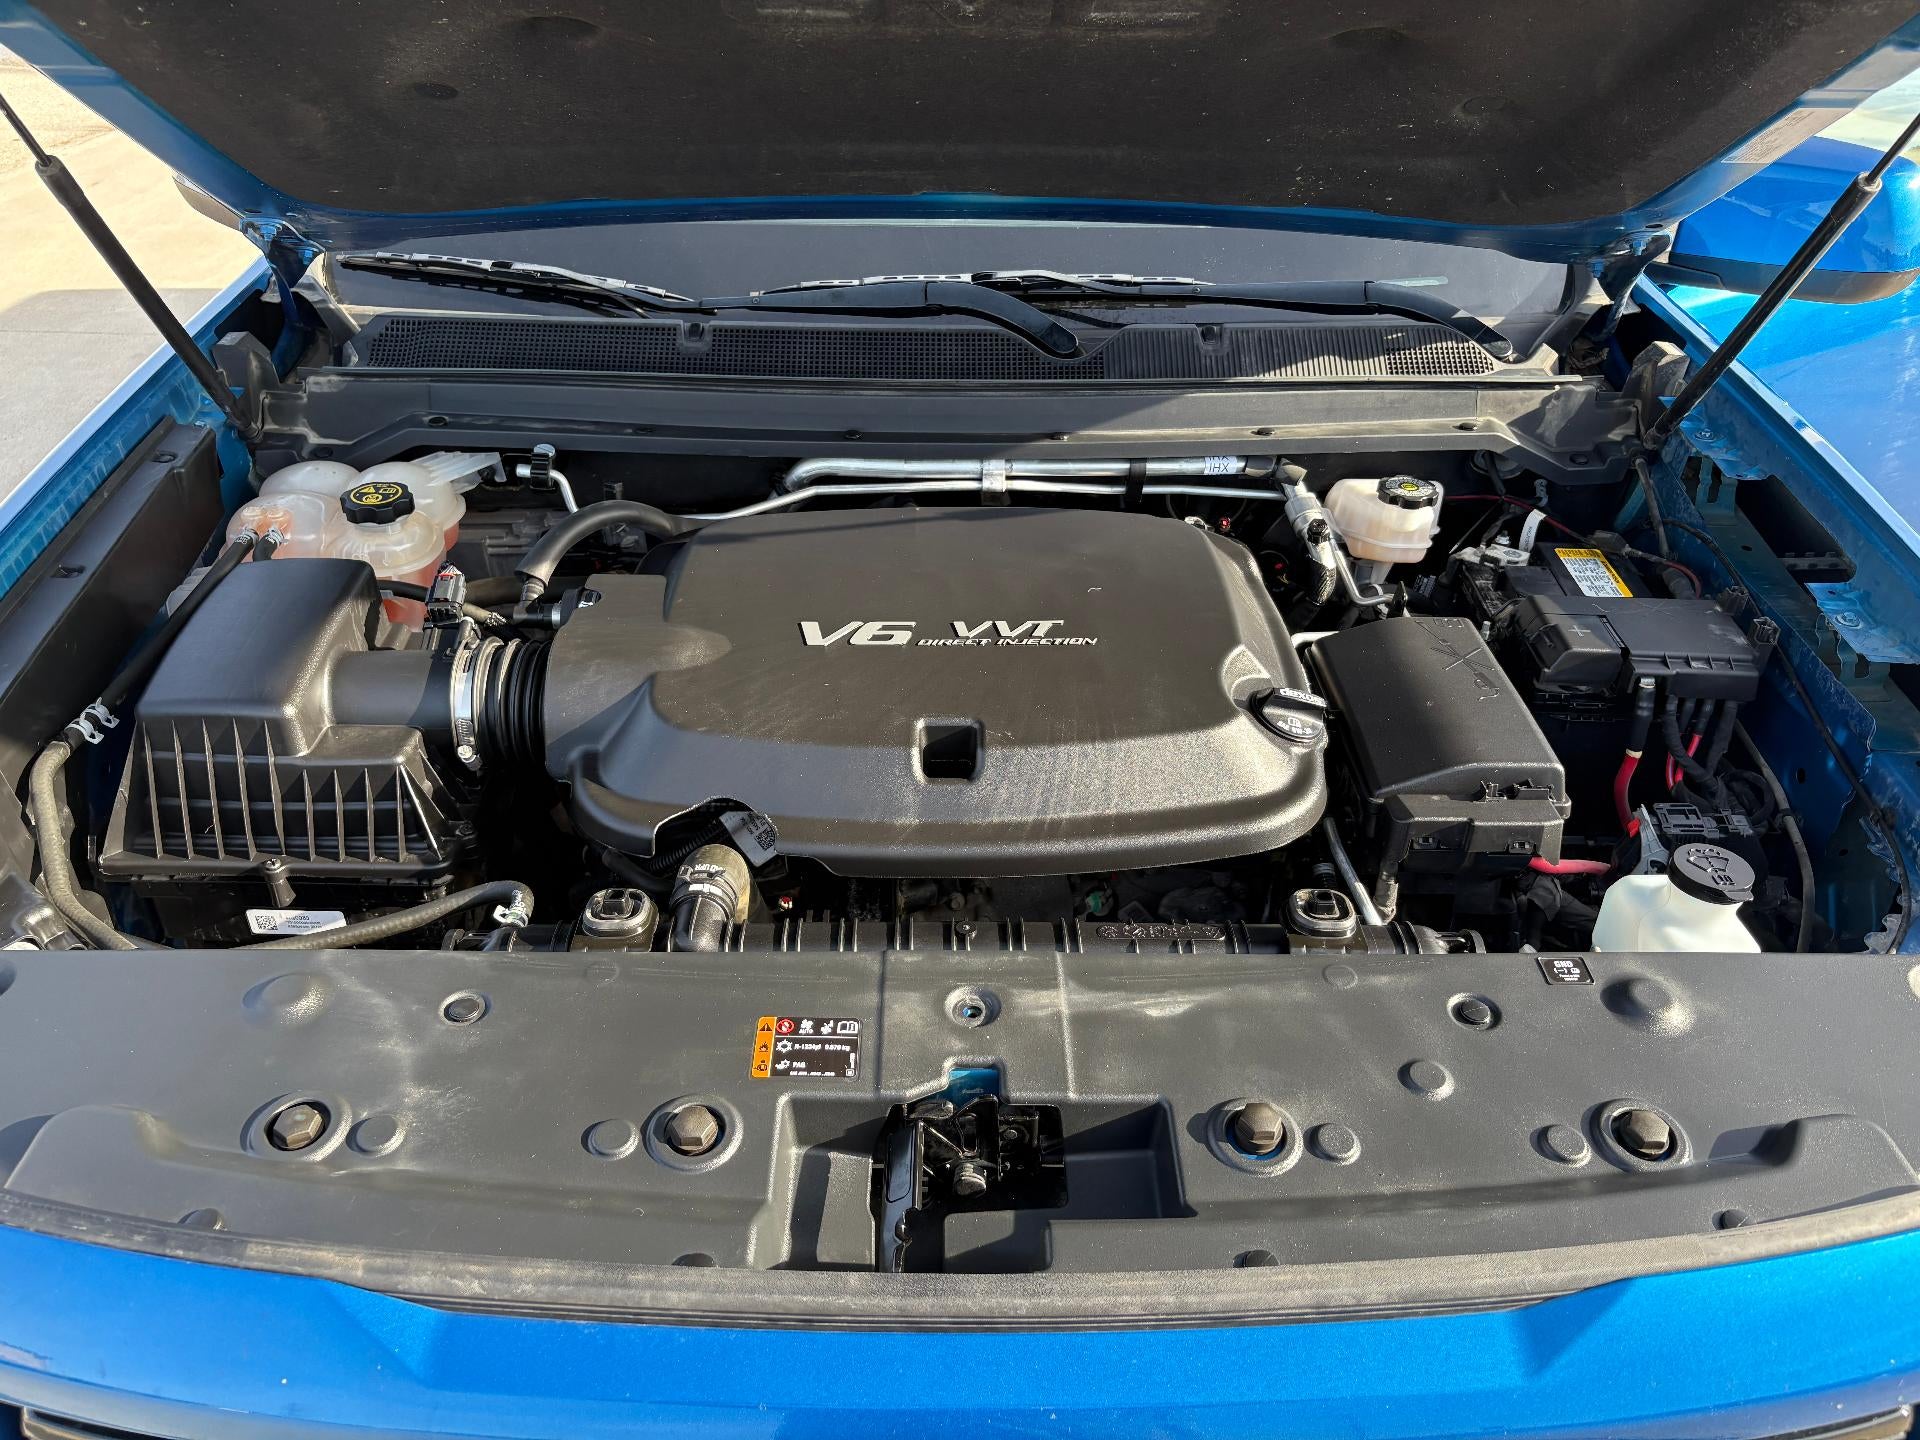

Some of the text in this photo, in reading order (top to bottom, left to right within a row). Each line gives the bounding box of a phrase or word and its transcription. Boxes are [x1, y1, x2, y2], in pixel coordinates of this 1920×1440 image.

[799, 620, 1064, 646] V6 VVT
[915, 637, 1098, 647] DIRECT INJECTION
